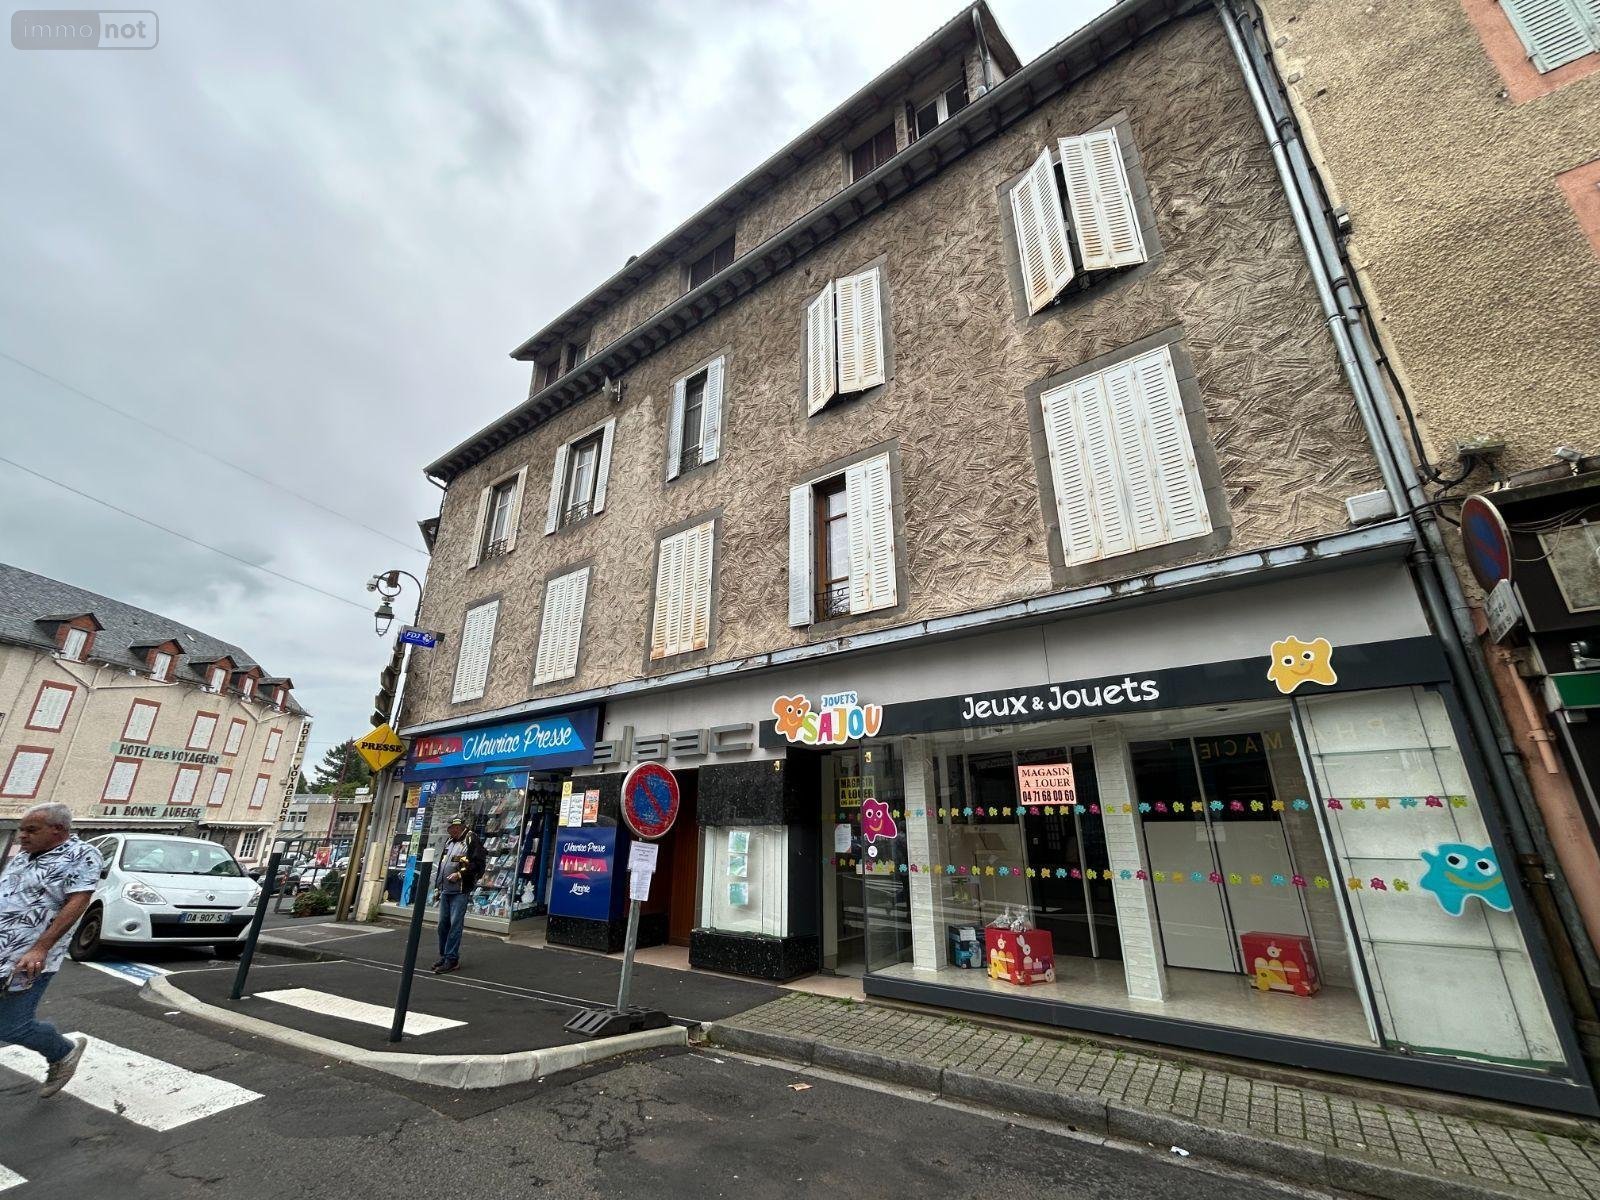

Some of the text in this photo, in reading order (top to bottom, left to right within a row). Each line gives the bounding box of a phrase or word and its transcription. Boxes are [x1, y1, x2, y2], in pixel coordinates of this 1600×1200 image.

[823, 693, 857, 707] JOUETS
[962, 677, 1159, 720] Jeux & Jouets
[803, 707, 881, 742] SAJOU
[361, 741, 403, 753] PRESSE
[462, 723, 572, 760] Mauriac Presse
[119, 744, 151, 758] HOTEL
[171, 750, 219, 765] VOYAGEURS
[278, 722, 311, 822] HOTEL VOYAGEURS
[1021, 767, 1070, 777] MAGASIN
[1024, 778, 1071, 788] A LOUER
[841, 789, 846, 799] A
[1022, 789, 1075, 802] 04 71 68 00 60
[103, 806, 202, 818] LA BONNE AUBERGE
[186, 914, 196, 922] DA
[199, 914, 214, 922] 907
